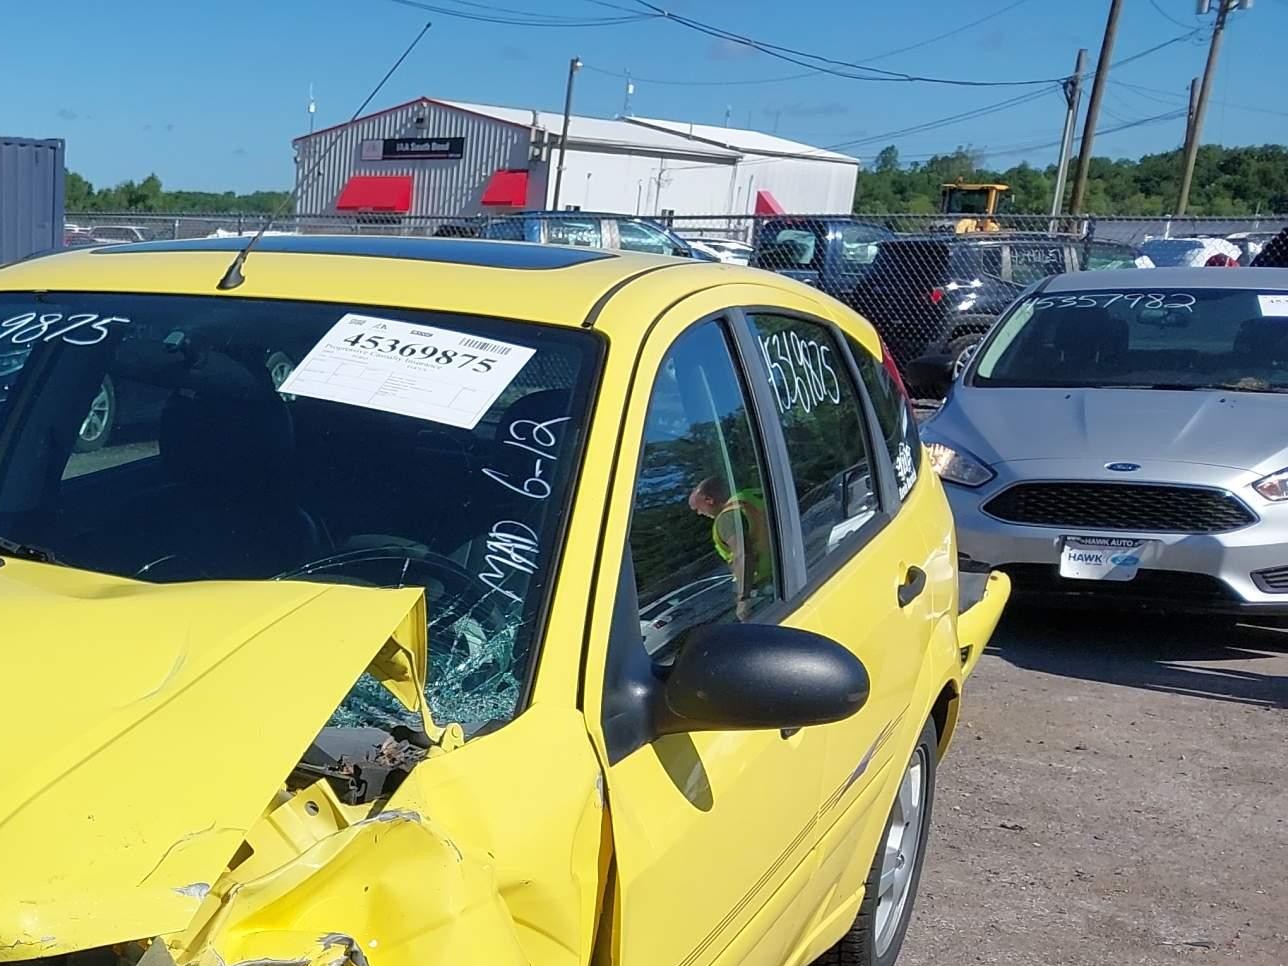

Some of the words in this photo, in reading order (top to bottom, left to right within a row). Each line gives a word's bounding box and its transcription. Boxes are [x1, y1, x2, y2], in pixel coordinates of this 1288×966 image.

[1020, 293, 1197, 313] 45357982
[343, 332, 498, 373] 45369875
[481, 416, 572, 498] 6-12
[1085, 538, 1109, 547] HAWK
[1110, 539, 1133, 547] AUTO
[1067, 553, 1104, 563] HAWK
